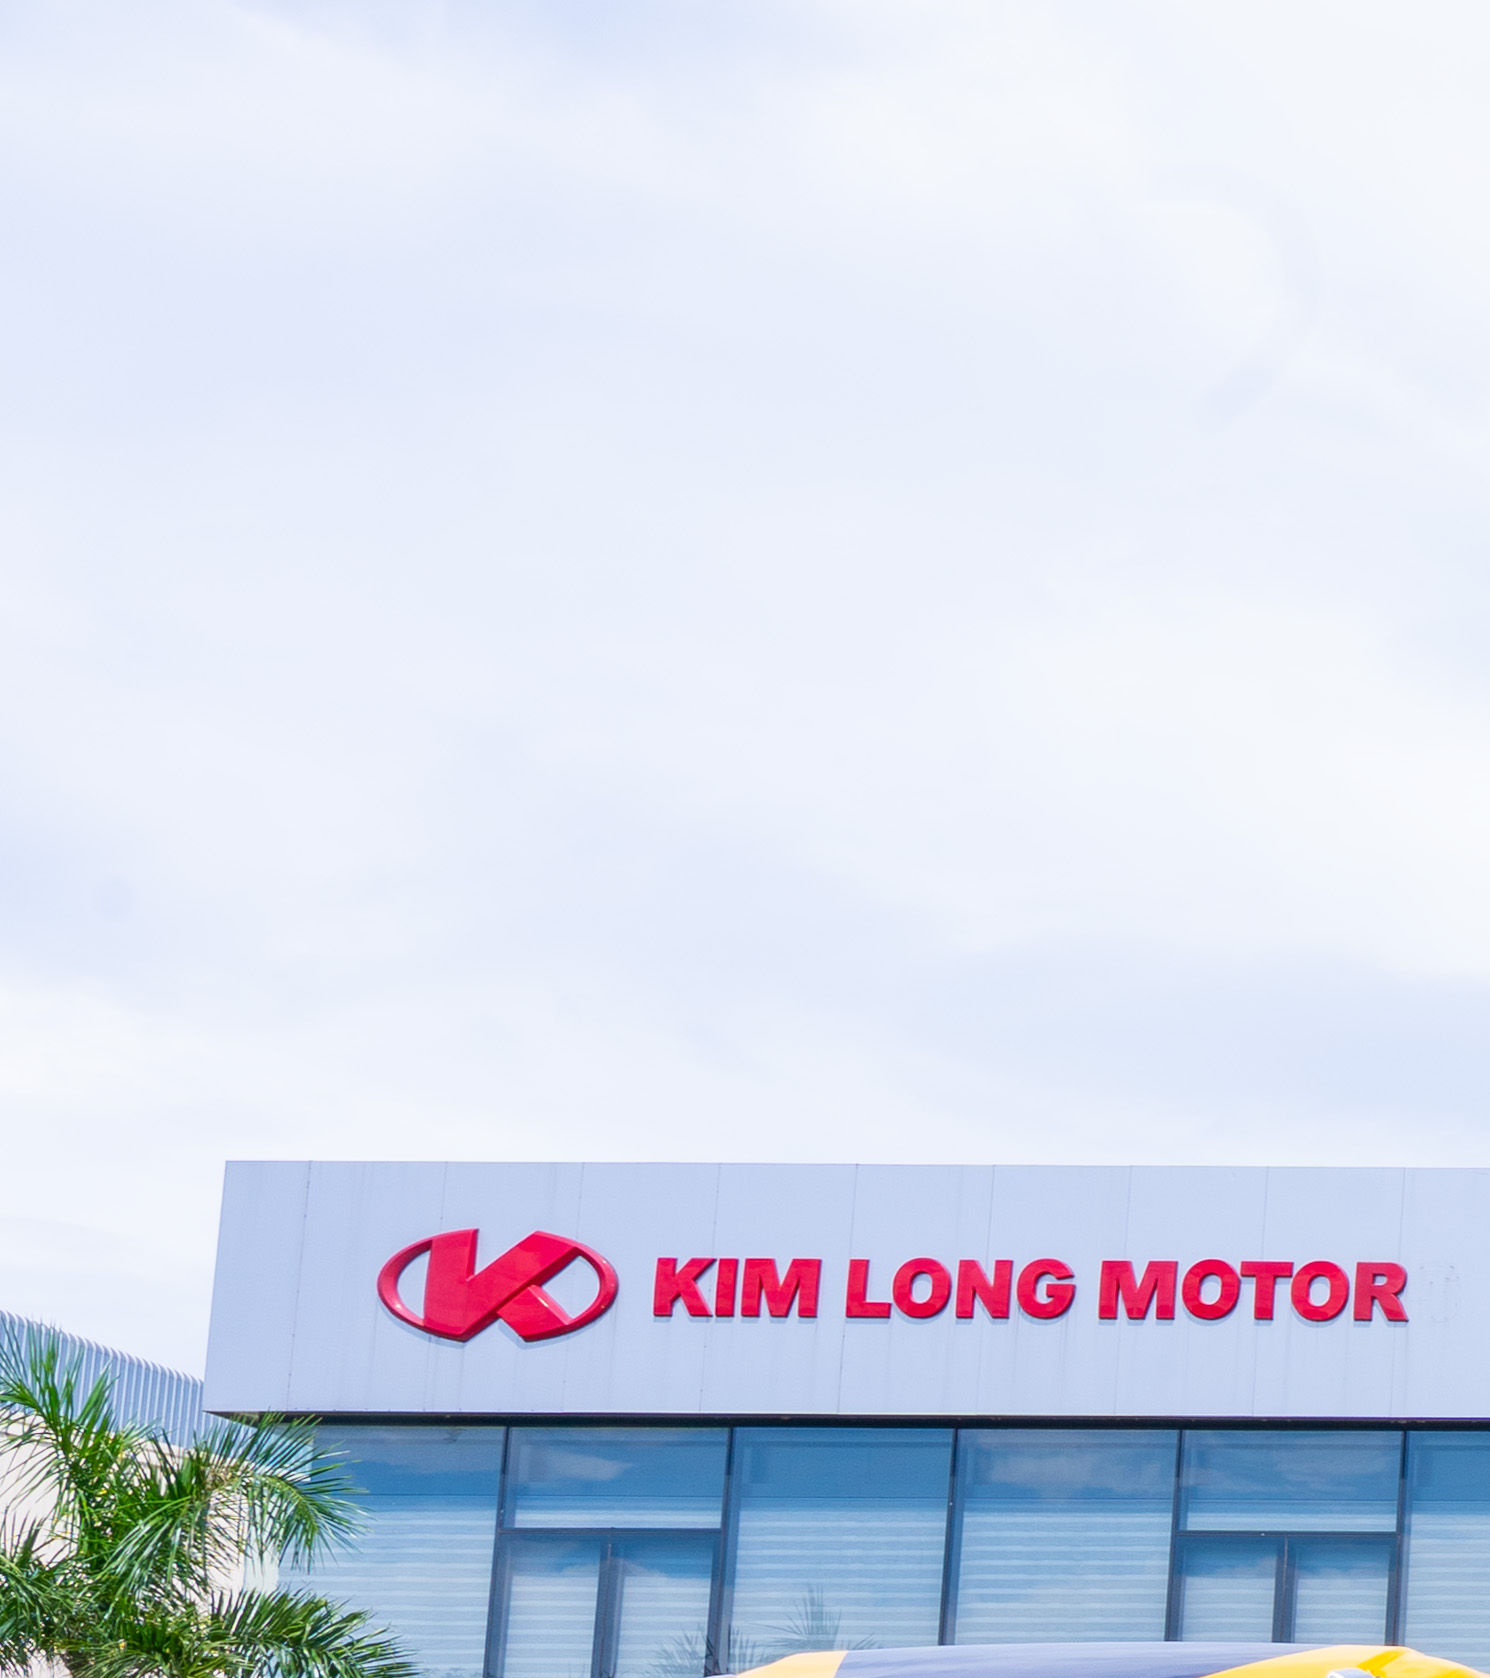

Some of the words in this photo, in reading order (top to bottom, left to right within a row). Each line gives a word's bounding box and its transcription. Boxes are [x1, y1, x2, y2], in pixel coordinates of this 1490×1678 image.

[653, 1257, 822, 1318] KIM
[845, 1258, 1077, 1320] LONG
[1099, 1260, 1409, 1322] MOTOR
